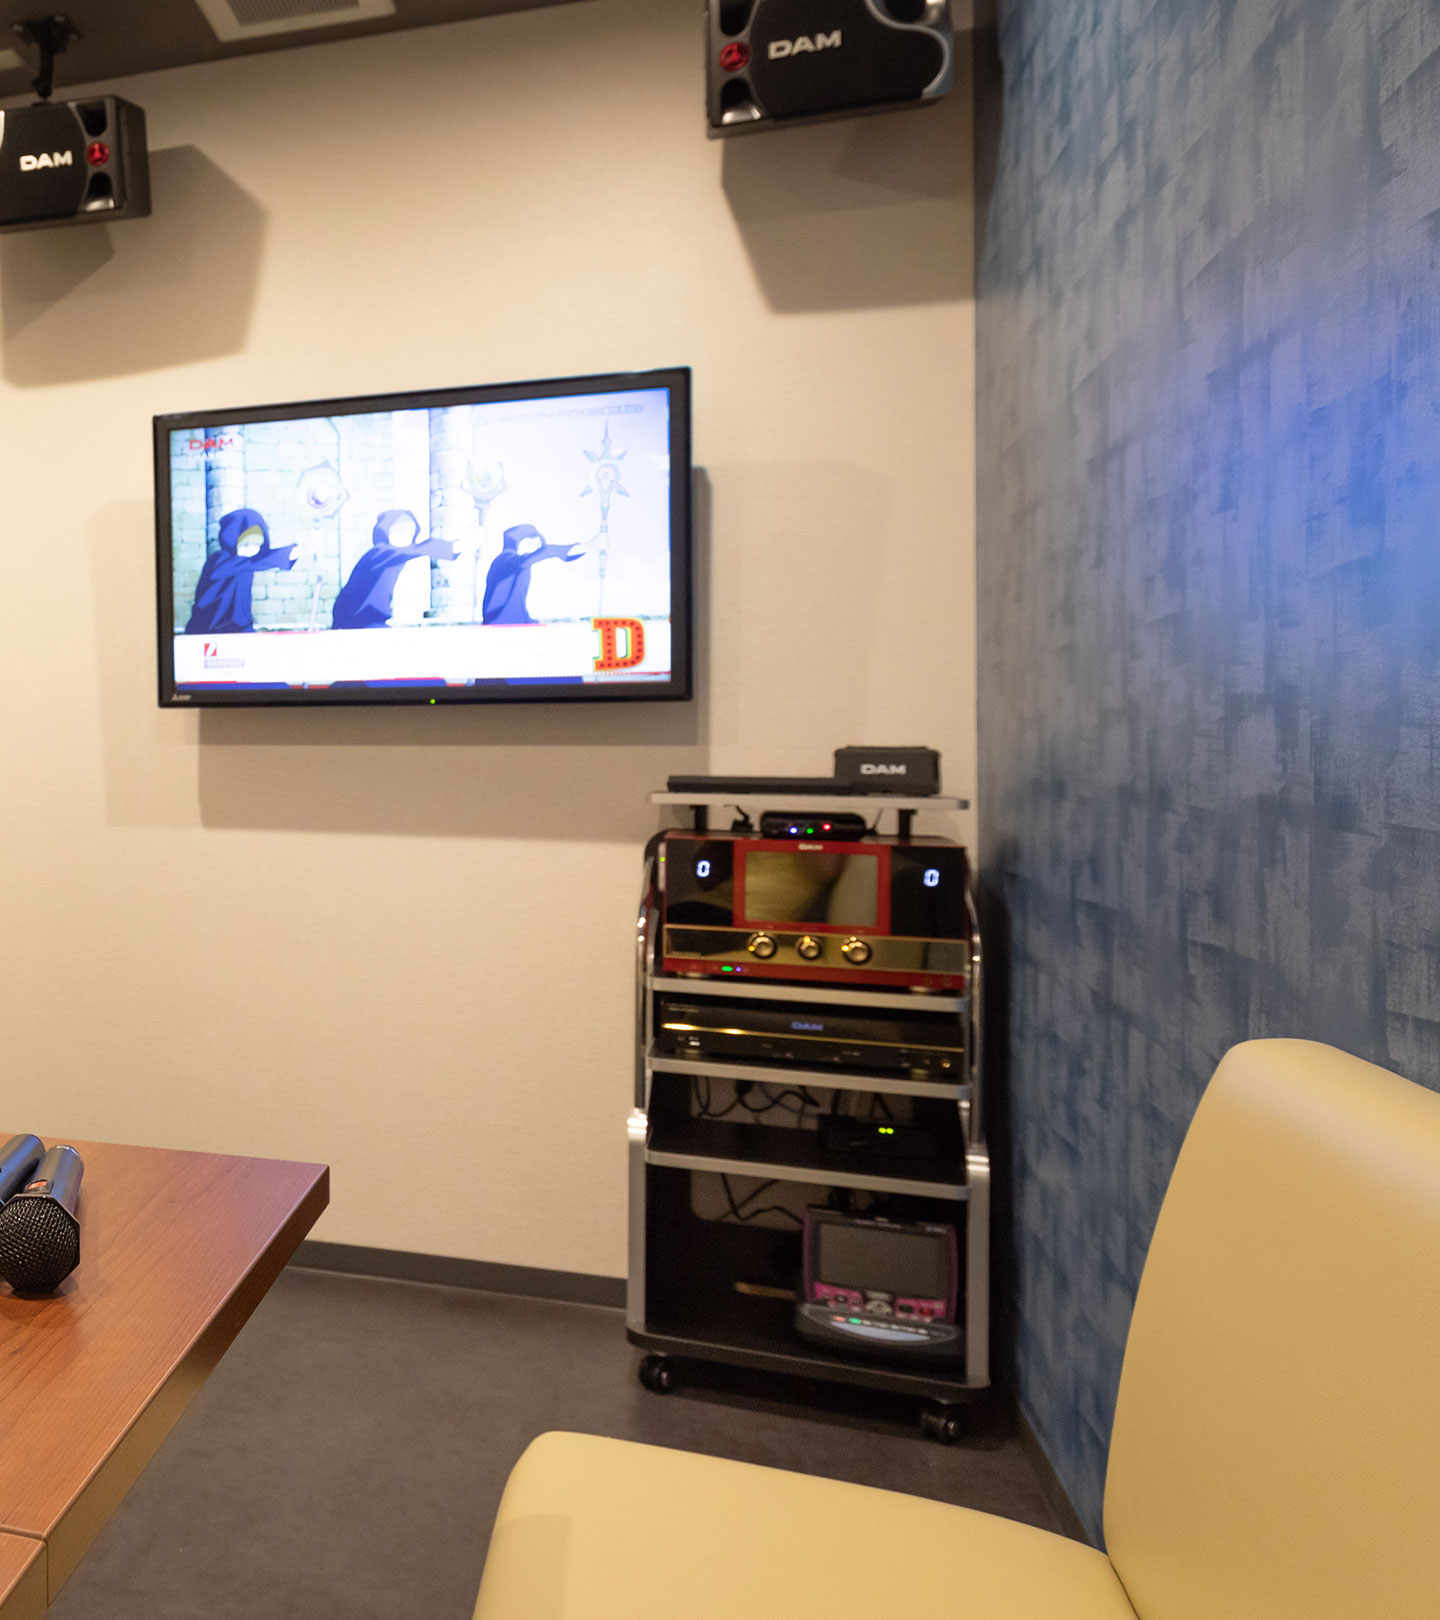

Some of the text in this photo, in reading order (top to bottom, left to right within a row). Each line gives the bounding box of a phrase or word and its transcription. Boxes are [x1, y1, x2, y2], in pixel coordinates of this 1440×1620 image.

[768, 29, 842, 60] DAM
[20, 150, 73, 172] DAM
[592, 617, 646, 672] D
[860, 763, 907, 776] DAM
[696, 860, 711, 878] 0
[923, 869, 940, 888] 0
